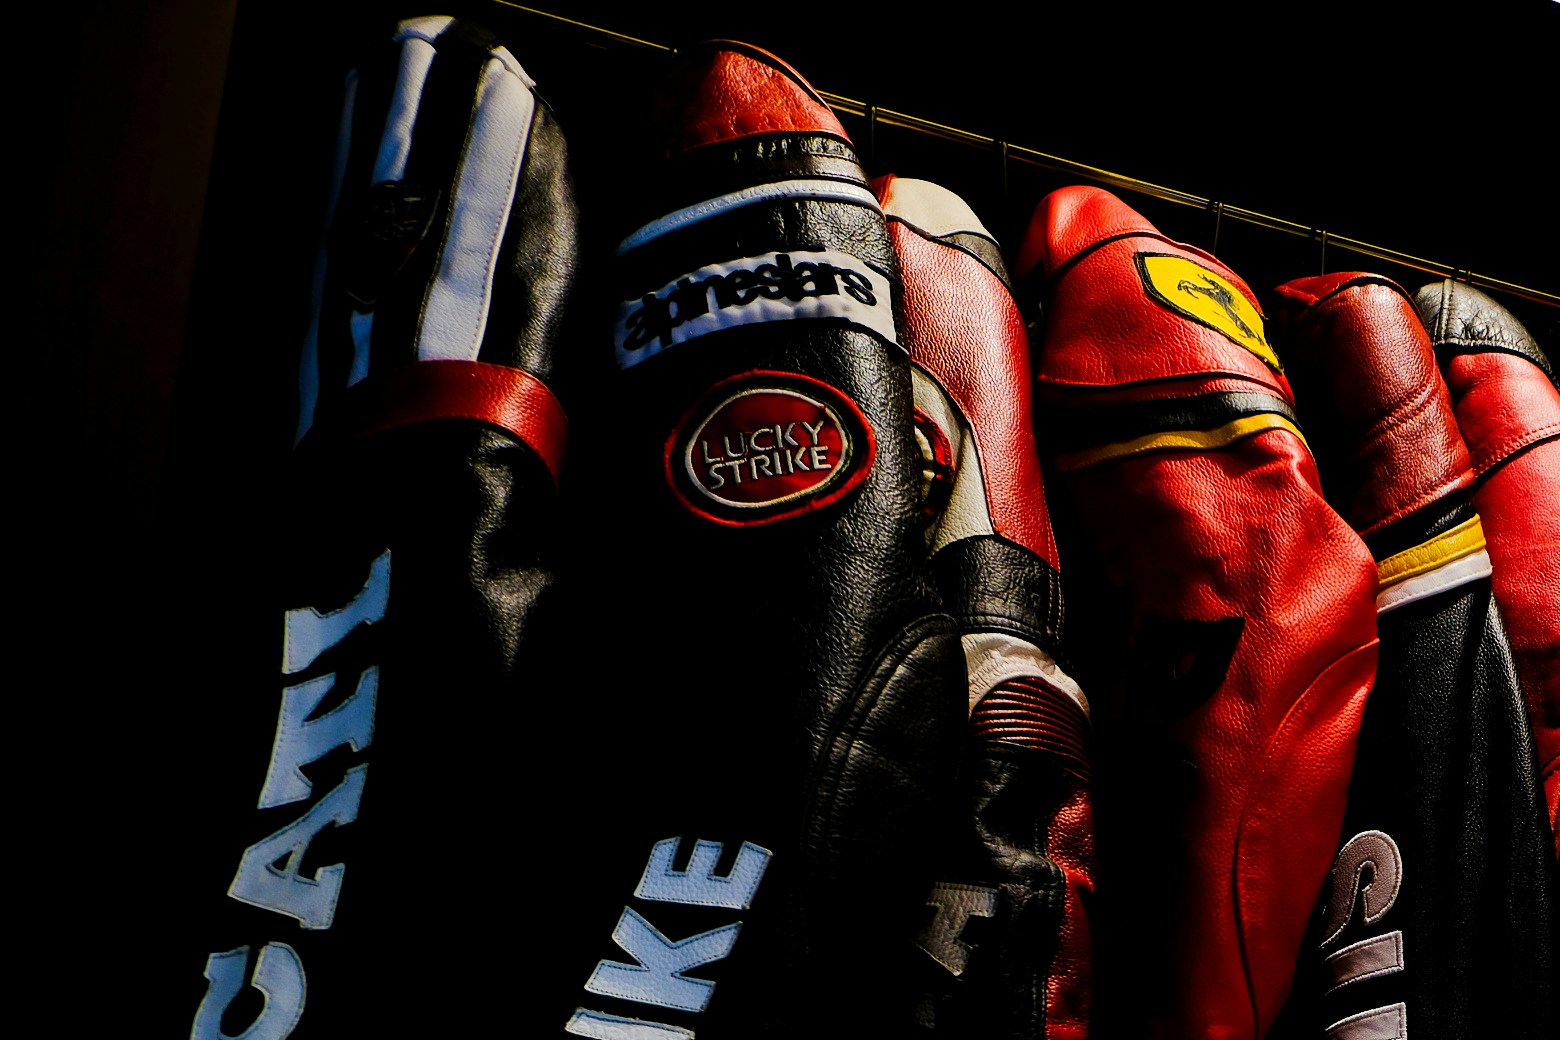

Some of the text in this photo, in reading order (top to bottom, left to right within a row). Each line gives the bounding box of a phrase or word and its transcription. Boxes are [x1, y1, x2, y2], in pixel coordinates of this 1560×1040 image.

[622, 253, 877, 351] alpinestars
[701, 419, 826, 464] LUCKY
[708, 445, 832, 490] STRIKE
